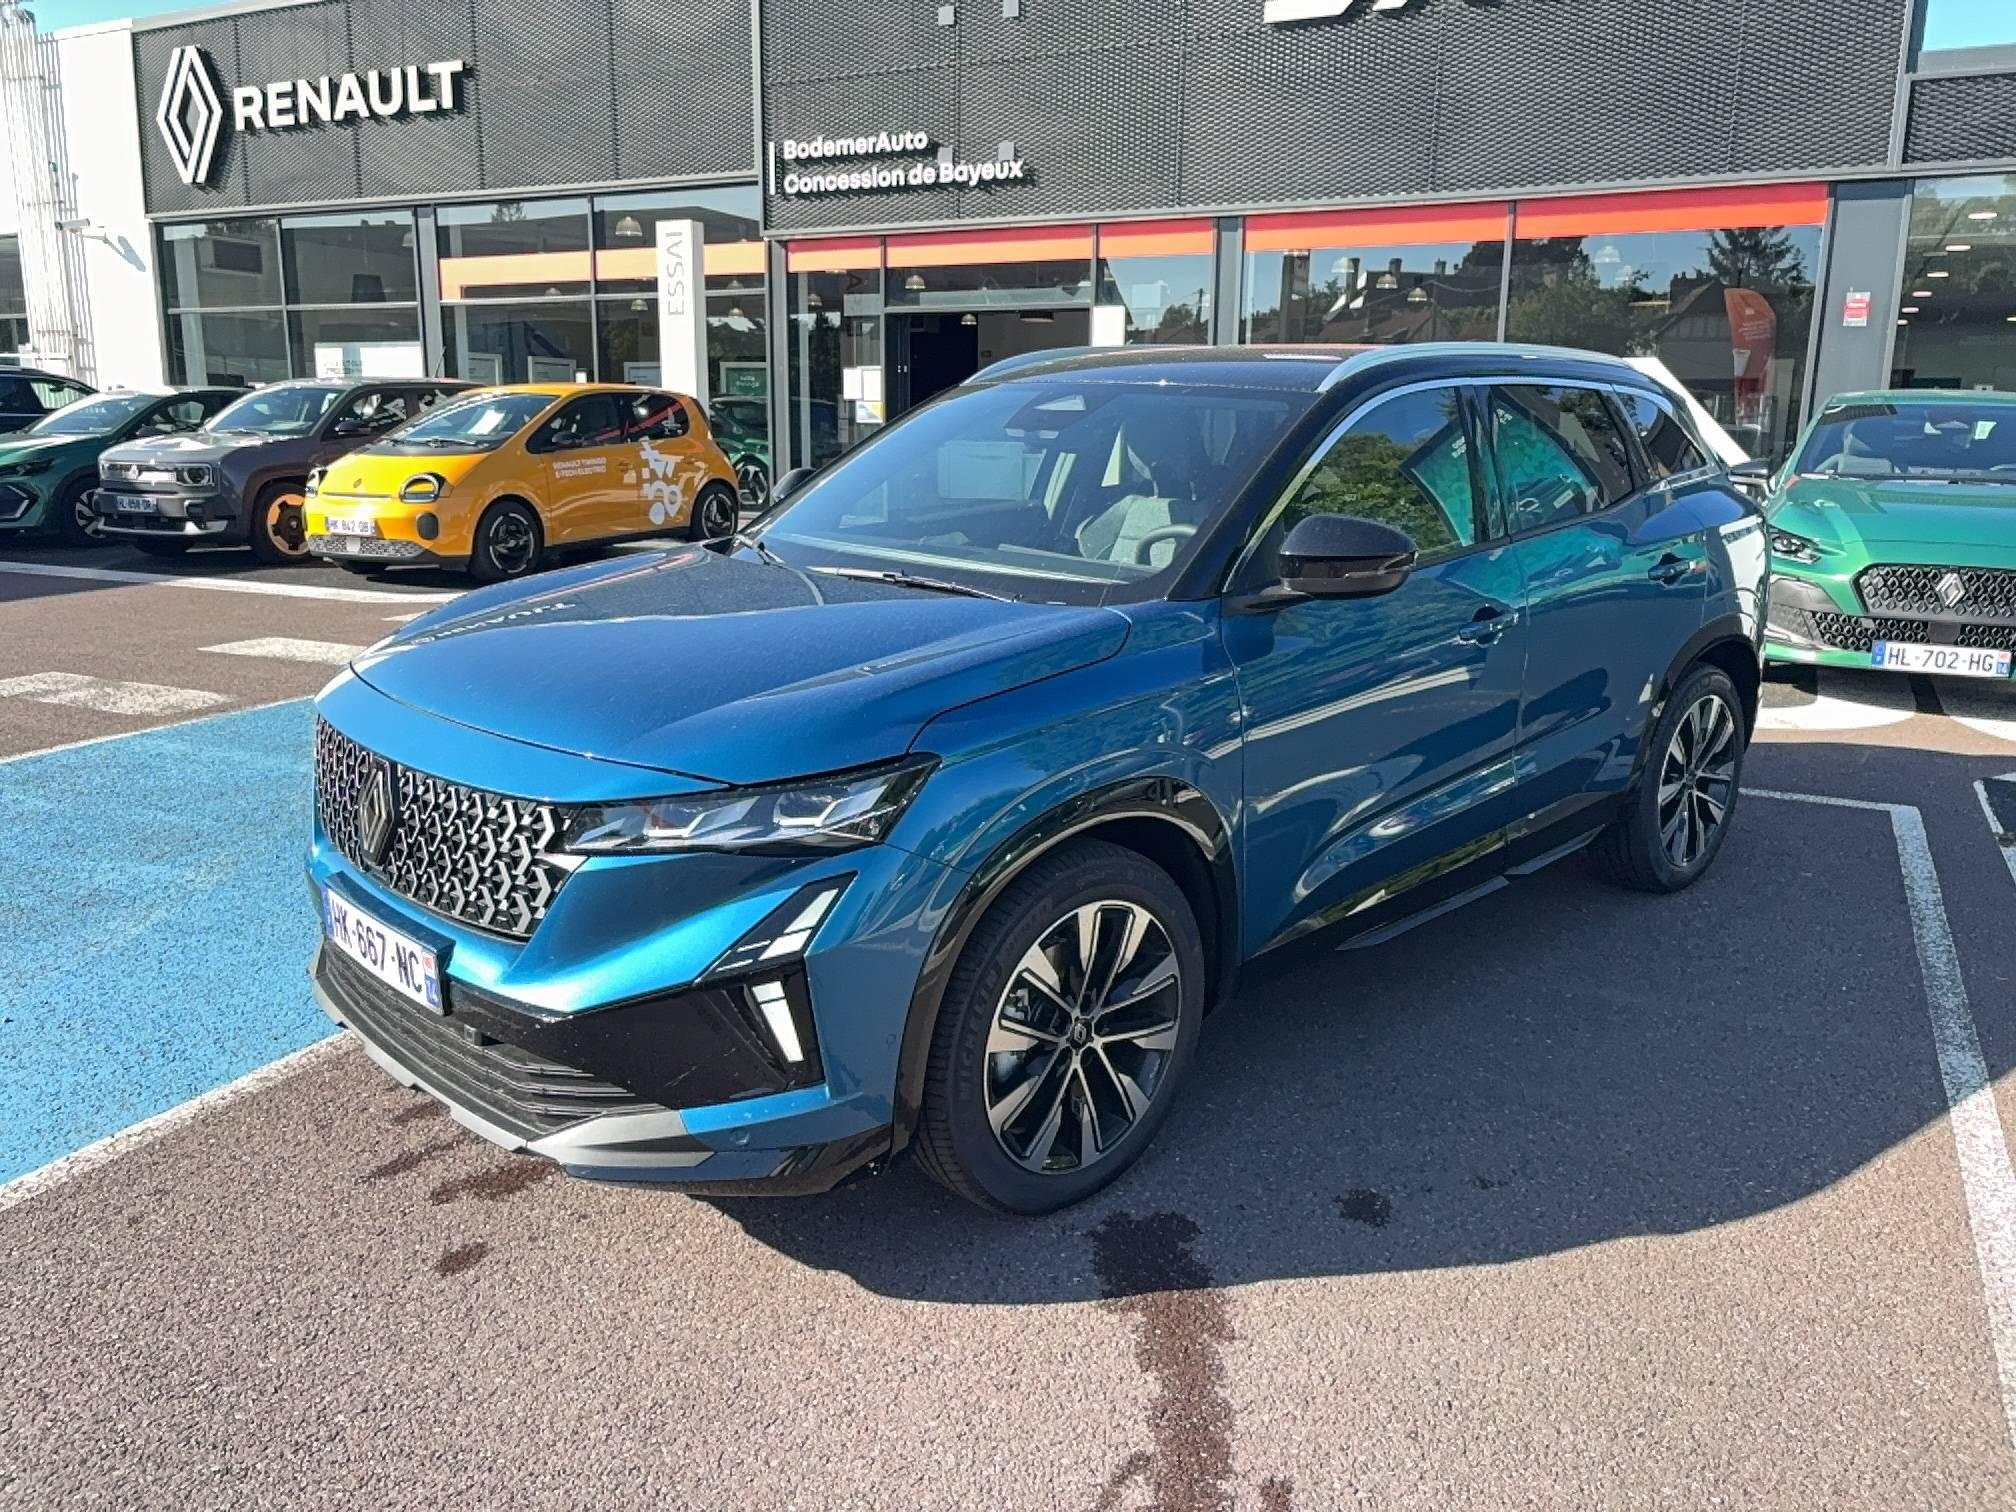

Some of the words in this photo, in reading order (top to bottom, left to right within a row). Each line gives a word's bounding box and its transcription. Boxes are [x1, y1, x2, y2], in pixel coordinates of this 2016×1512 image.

[233, 60, 463, 131] RENAULT
[783, 131, 929, 160] BodemerAuto
[783, 167, 905, 194] Concession
[908, 163, 937, 184] de
[938, 160, 1024, 186] Bayeux
[665, 231, 685, 315] ESSAI
[1887, 647, 1994, 672] HL-702-HG
